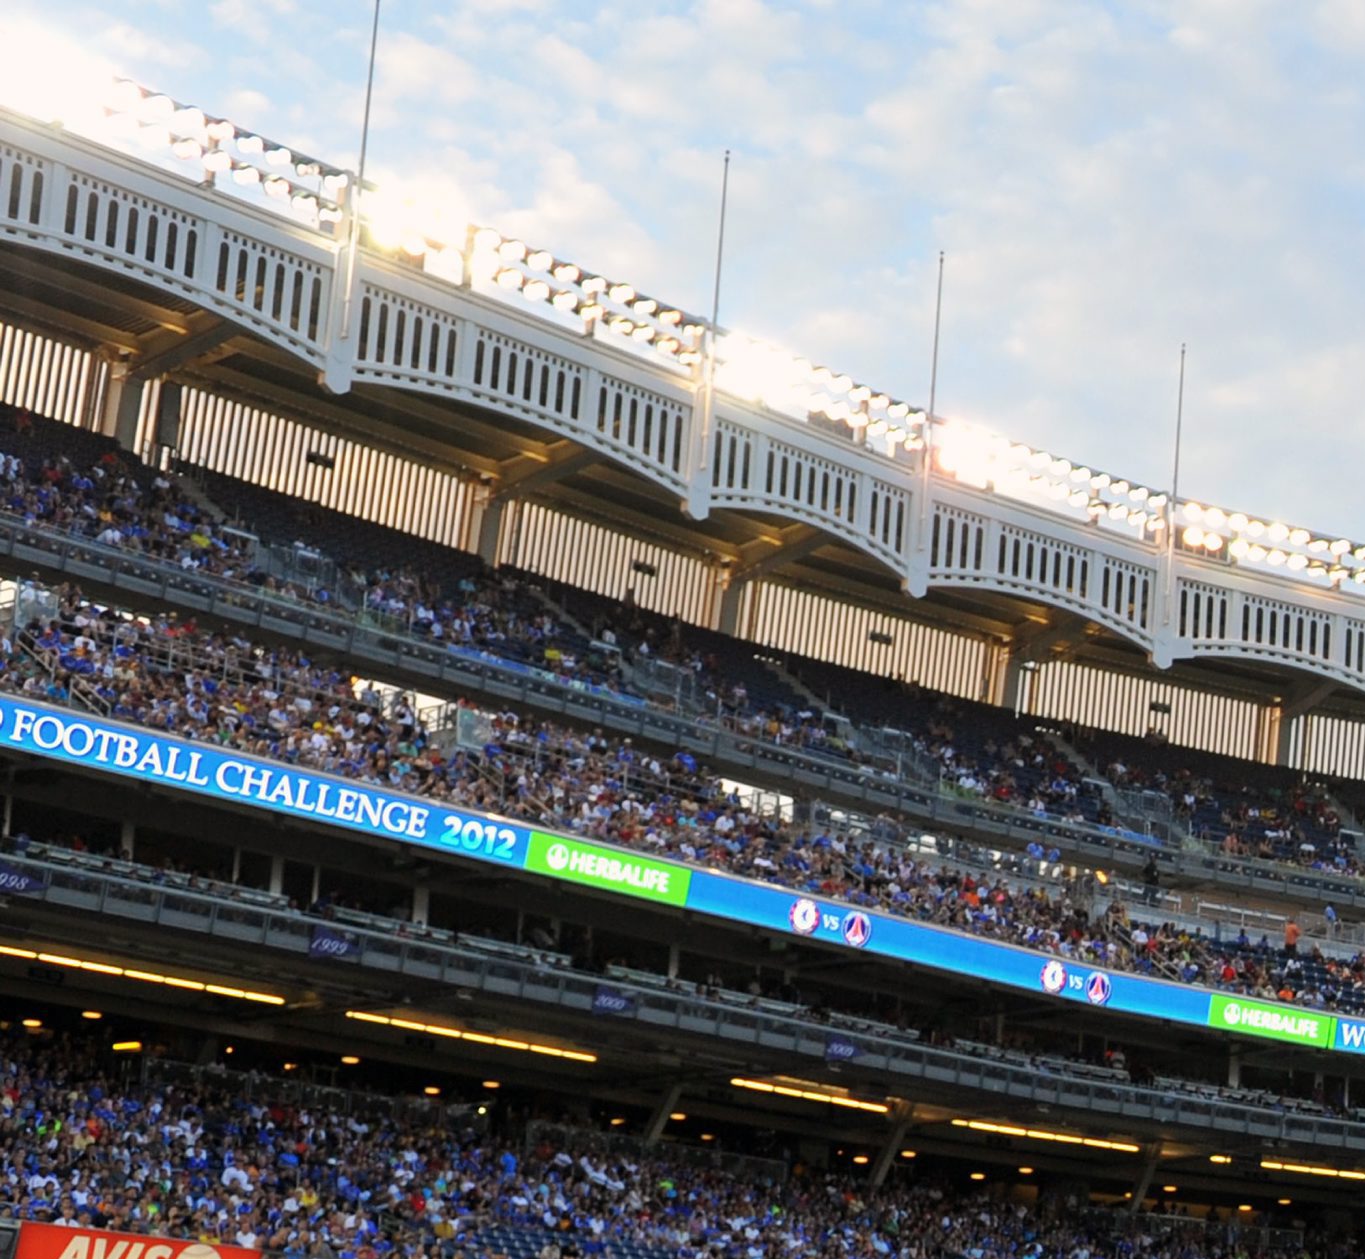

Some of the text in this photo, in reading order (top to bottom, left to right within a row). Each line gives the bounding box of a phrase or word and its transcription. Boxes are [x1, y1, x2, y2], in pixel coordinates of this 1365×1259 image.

[9, 708, 518, 859] FOOTBALL CHALLENGE 2012
[569, 850, 672, 893] HERBALIFE
[311, 934, 349, 956] 1999
[1241, 1008, 1319, 1038] HERBALIFE
